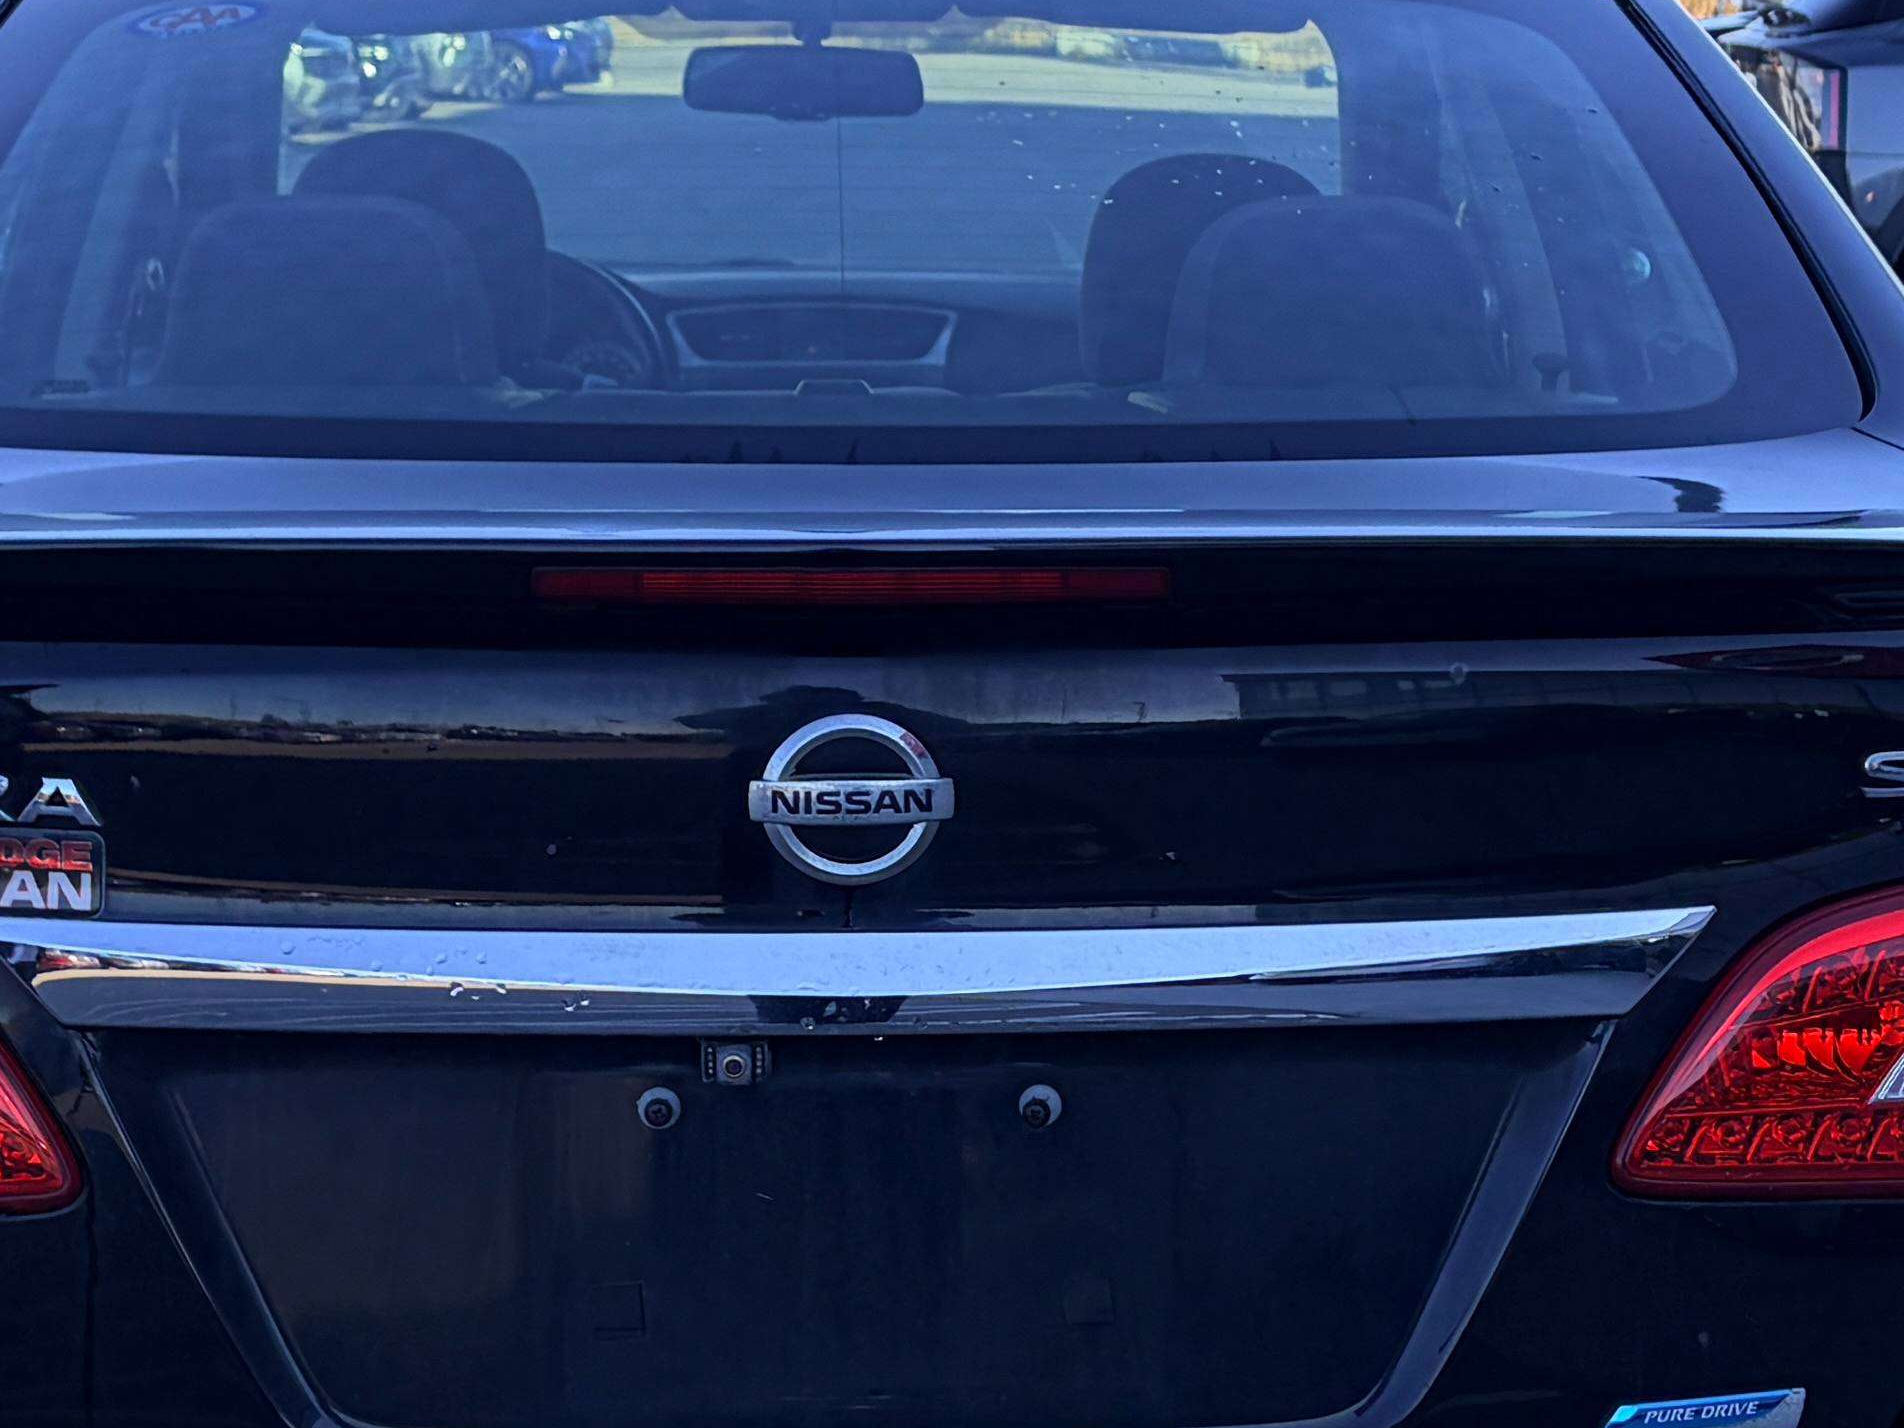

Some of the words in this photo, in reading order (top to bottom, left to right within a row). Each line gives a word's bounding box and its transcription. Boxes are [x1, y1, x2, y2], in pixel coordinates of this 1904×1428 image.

[770, 788, 934, 815] NISSAN
[1643, 1406, 1696, 1424] PURE
[1701, 1400, 1760, 1420] DRIVE
